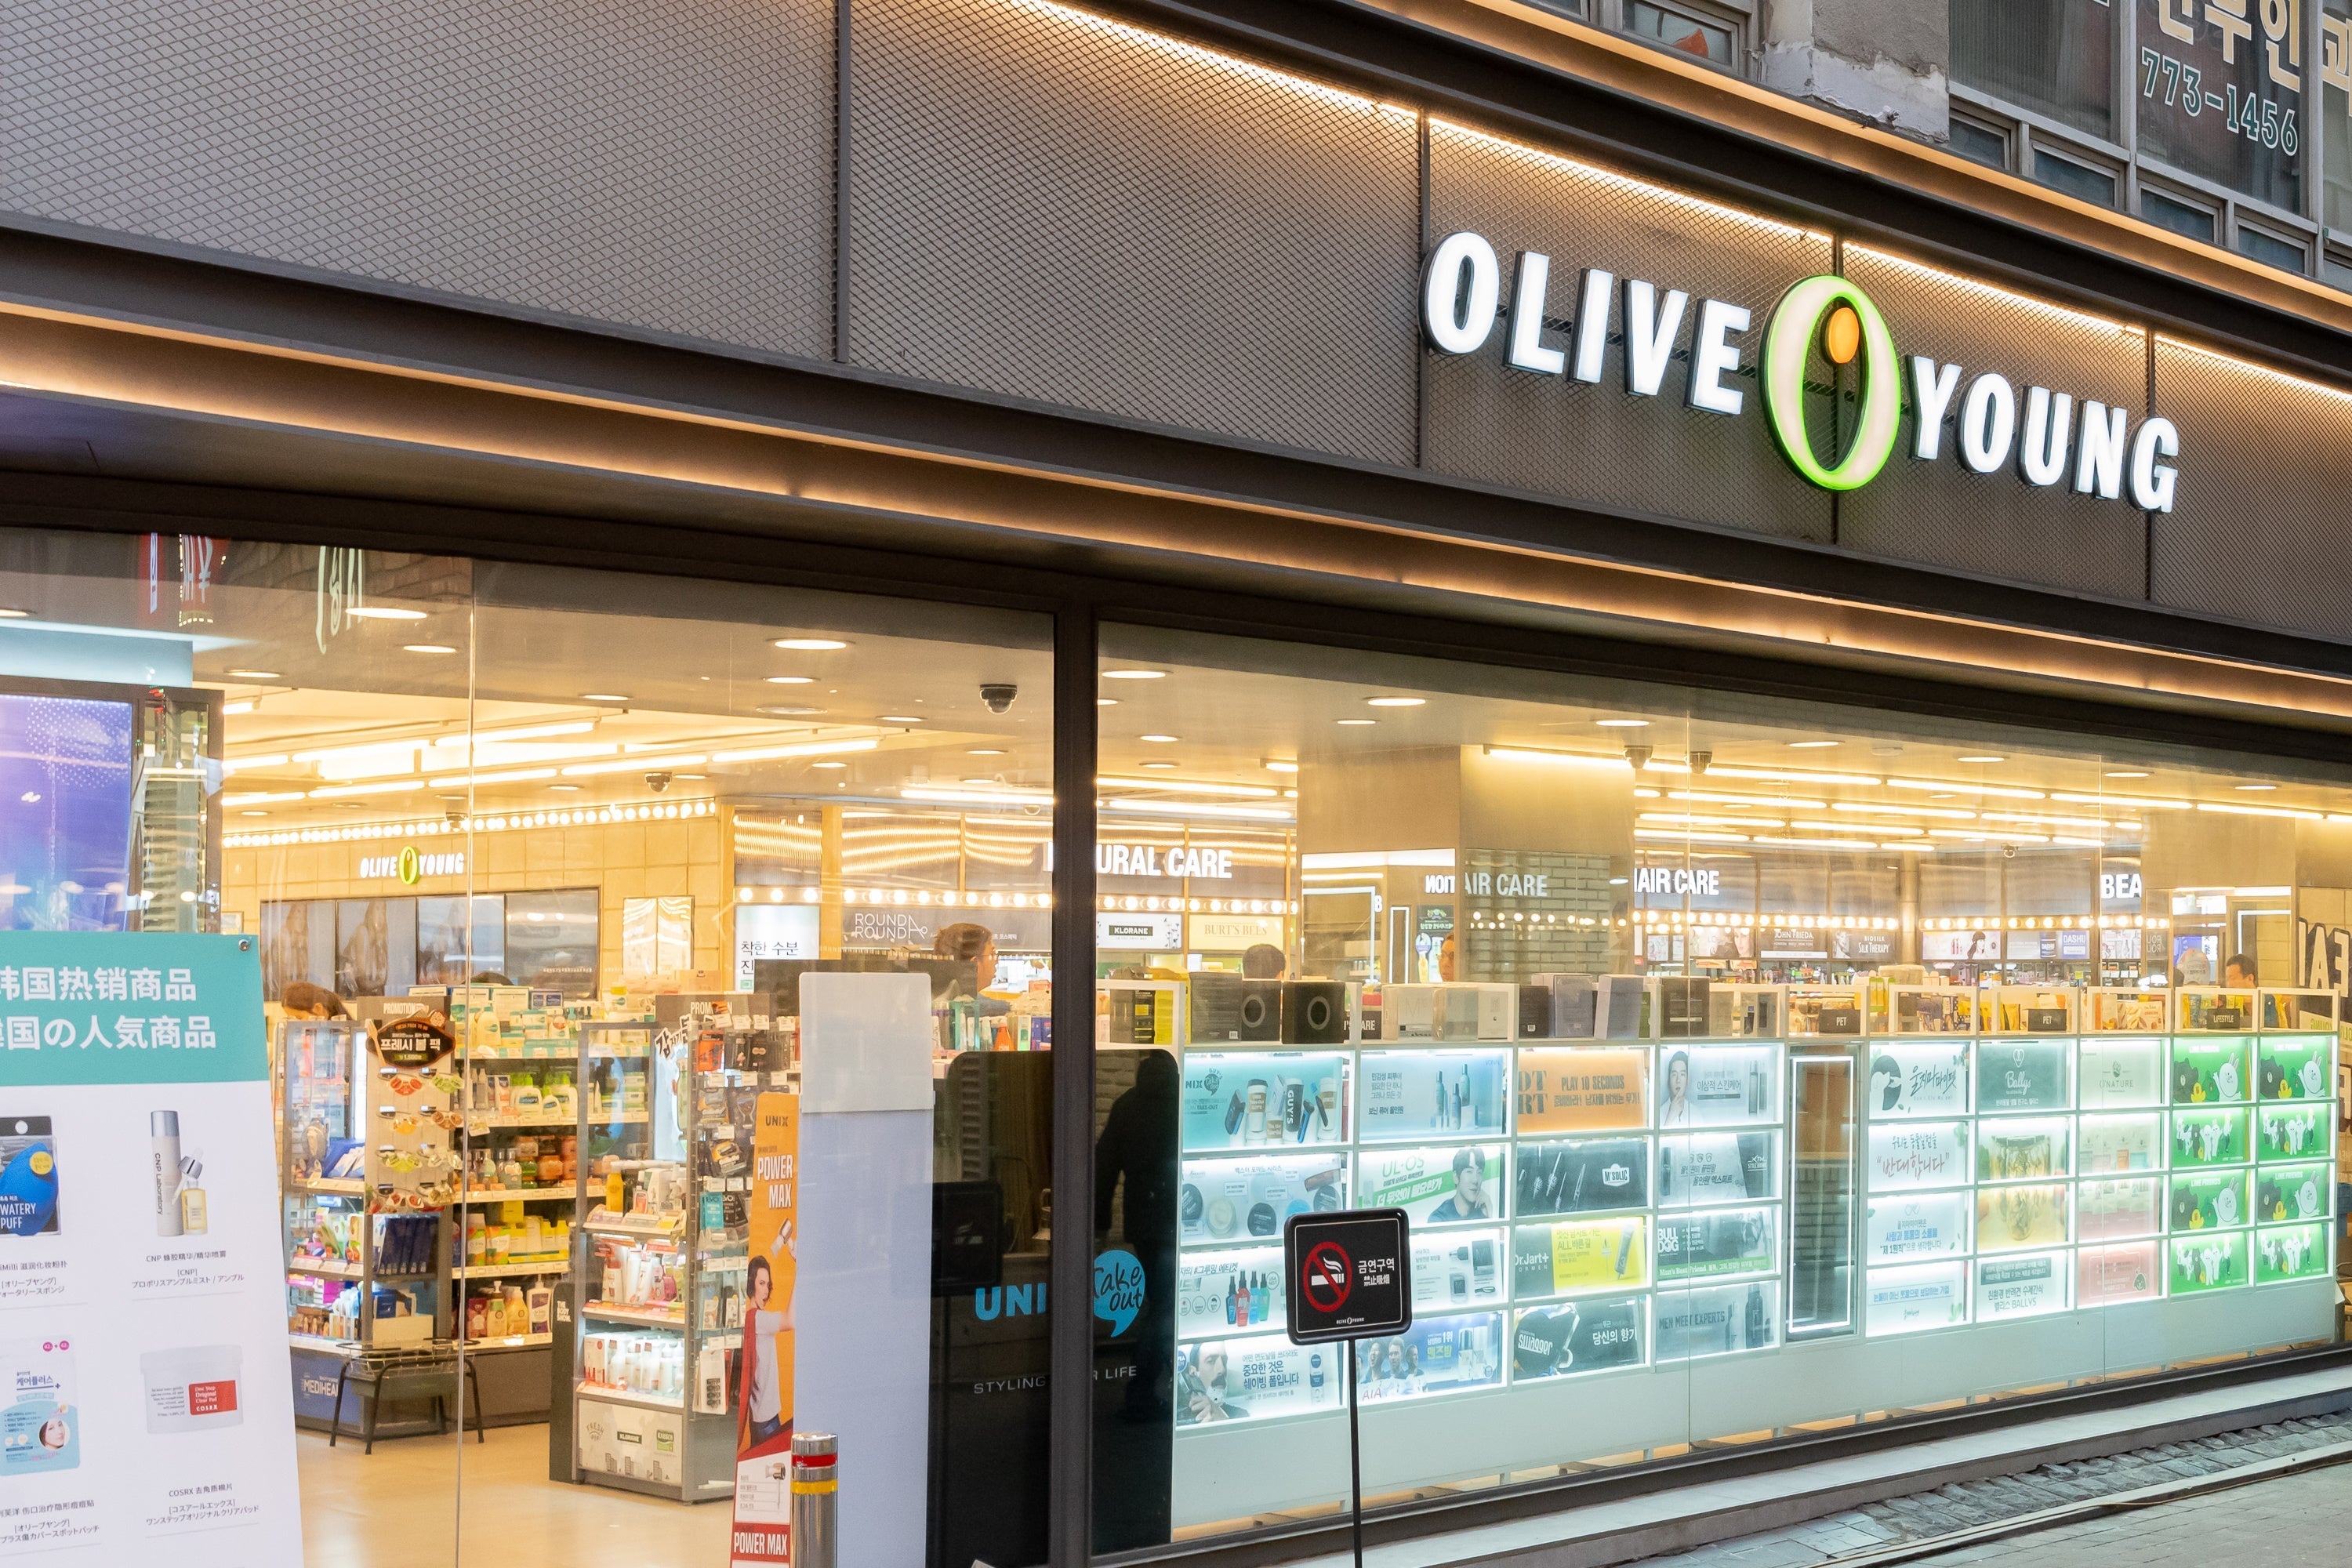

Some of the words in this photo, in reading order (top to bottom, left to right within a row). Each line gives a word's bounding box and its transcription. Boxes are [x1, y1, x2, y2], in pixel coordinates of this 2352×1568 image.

[2141, 45, 2299, 156] 773-1456
[1422, 231, 1751, 416] OLIVE
[1907, 354, 2180, 514] YOUNG
[360, 855, 397, 879] OLIVE
[419, 851, 465, 876] YOUNG
[1164, 847, 1233, 879] CARE
[1496, 873, 1548, 898] CARE
[1674, 869, 1720, 896] CARE
[855, 913, 907, 926] ROUND
[855, 926, 907, 939] ROUND
[1114, 926, 1149, 936] KLORANE
[1204, 924, 1241, 935] BURT'S
[1243, 925, 1267, 936] BEES
[1774, 928, 1791, 939] JOHN
[1791, 929, 1815, 940] FRIEDA
[2063, 934, 2086, 943] DASHU
[740, 941, 767, 956] 착한
[771, 941, 800, 956] 수분
[691, 1001, 733, 1015] PROMN
[1361, 1020, 1376, 1031] ARE
[1836, 1016, 1847, 1027] PET
[2042, 1015, 2053, 1025] PET
[2213, 1014, 2234, 1024] LIFESTYLE
[0, 1014, 216, 1051] 国の人気商品
[380, 1038, 412, 1051] 프레시
[1371, 1073, 1387, 1081] 민감성
[1562, 1076, 1578, 1091] PLAY
[1581, 1076, 1590, 1091] 10
[1592, 1075, 1625, 1091] SECONDS
[1185, 1080, 1203, 1090] NIX
[1697, 1080, 1715, 1091] 이상적
[1717, 1080, 1741, 1091] 스킨케어
[1370, 1091, 1385, 1100] 그러나
[766, 1115, 788, 1127] UNIX
[1892, 1134, 1908, 1150] 우리는
[757, 1154, 793, 1182] POWER
[1605, 1166, 1628, 1181] M'SOLIC
[1711, 1174, 1733, 1185] 엑스퍼트
[769, 1183, 792, 1210] MAX
[0, 1202, 37, 1217] WATERY
[0, 1217, 23, 1230] PUFF
[1658, 1227, 1679, 1241] BULL
[1658, 1240, 1679, 1253] DOG
[177, 1268, 198, 1277] [CNP]
[1180, 1266, 1192, 1276] 자의
[1218, 1262, 1239, 1273] 에티켓
[1357, 1257, 1395, 1274] 금연구역
[1660, 1267, 1676, 1276] Man's
[975, 1283, 1047, 1321] UNI
[1109, 1287, 1142, 1312] out
[2012, 1297, 2037, 1308] BALLYS
[1658, 1316, 1674, 1330] MEN
[1694, 1310, 1726, 1327] EXPERTS
[1592, 1329, 1618, 1345] 당신의
[1243, 1361, 1267, 1377] 중요한
[1268, 1359, 1284, 1374] 것은
[974, 1375, 1047, 1394] STYLING
[1105, 1365, 1138, 1380] LIFE
[1243, 1376, 1267, 1391] 쉐이빙
[1269, 1371, 1300, 1388] 폼입니다
[1362, 1385, 1382, 1401] AIA
[169, 1488, 194, 1497] COSRX
[734, 1531, 765, 1555] POWER
[767, 1533, 788, 1556] MAX
